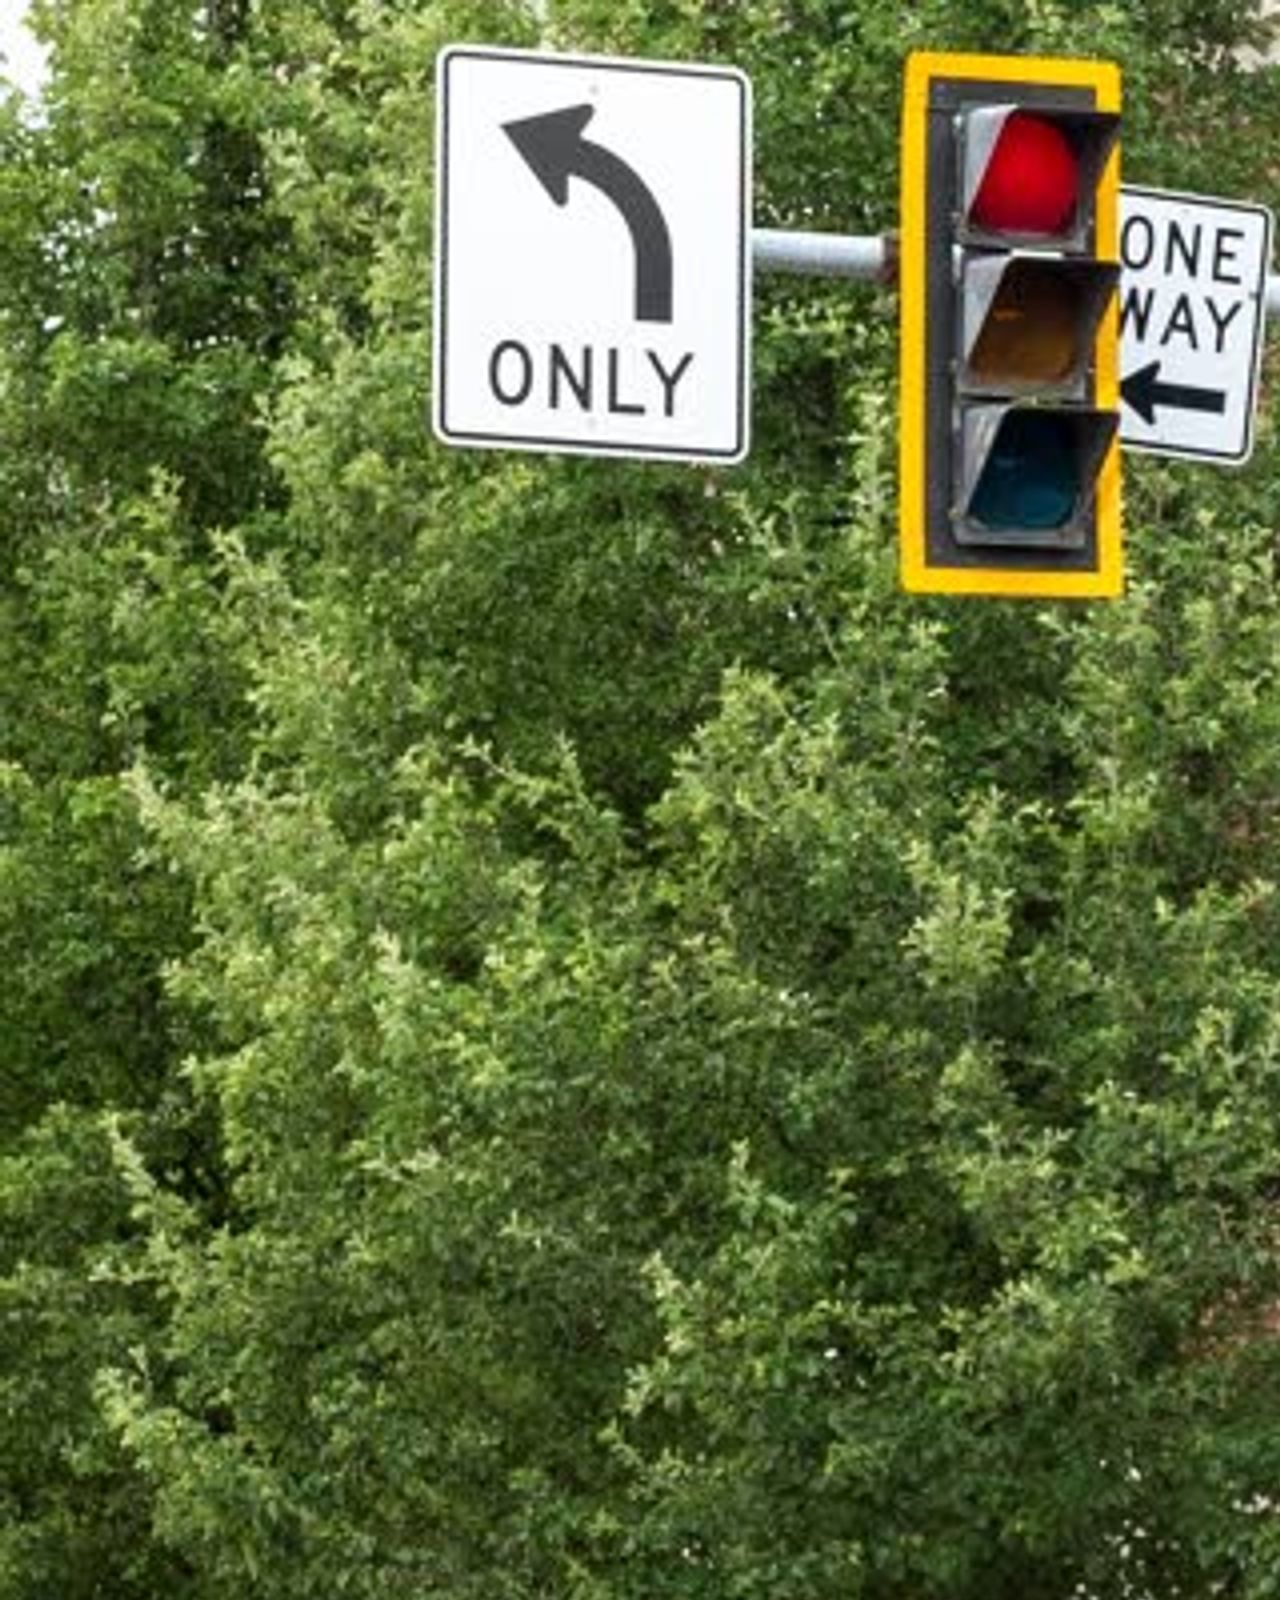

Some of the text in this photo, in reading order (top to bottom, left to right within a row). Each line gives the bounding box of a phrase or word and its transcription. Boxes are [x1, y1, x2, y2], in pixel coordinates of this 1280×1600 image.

[1120, 214, 1245, 285] ONE
[1117, 287, 1242, 353] WAY
[489, 339, 694, 418] ONLY
